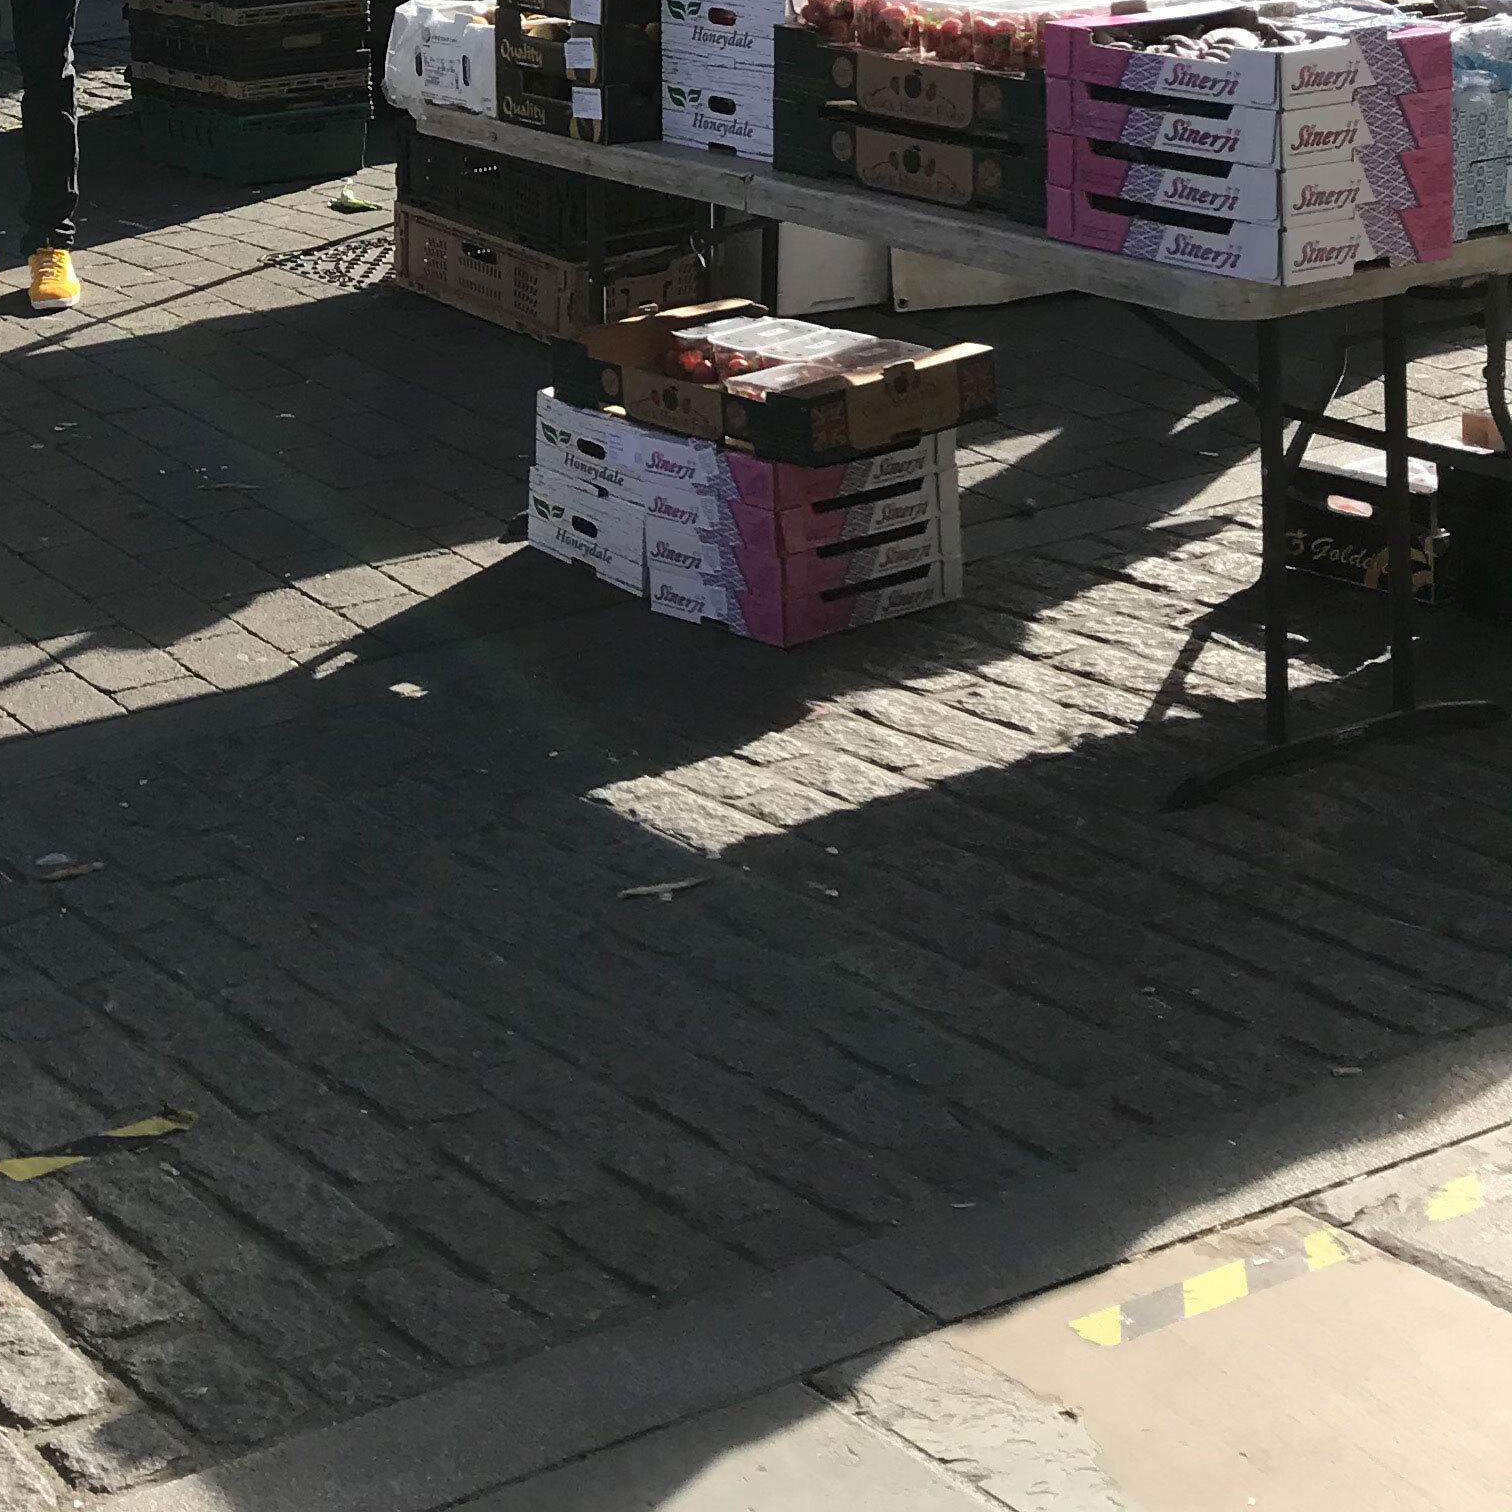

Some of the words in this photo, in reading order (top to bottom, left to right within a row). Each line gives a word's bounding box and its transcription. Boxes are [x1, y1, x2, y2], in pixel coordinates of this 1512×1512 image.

[500, 38, 543, 69] Quality
[691, 25, 755, 51] Honeydale
[502, 95, 546, 126] Quality
[691, 112, 755, 139] Honeydale
[564, 451, 625, 487] Honeydale
[555, 527, 614, 565] Honeydale
